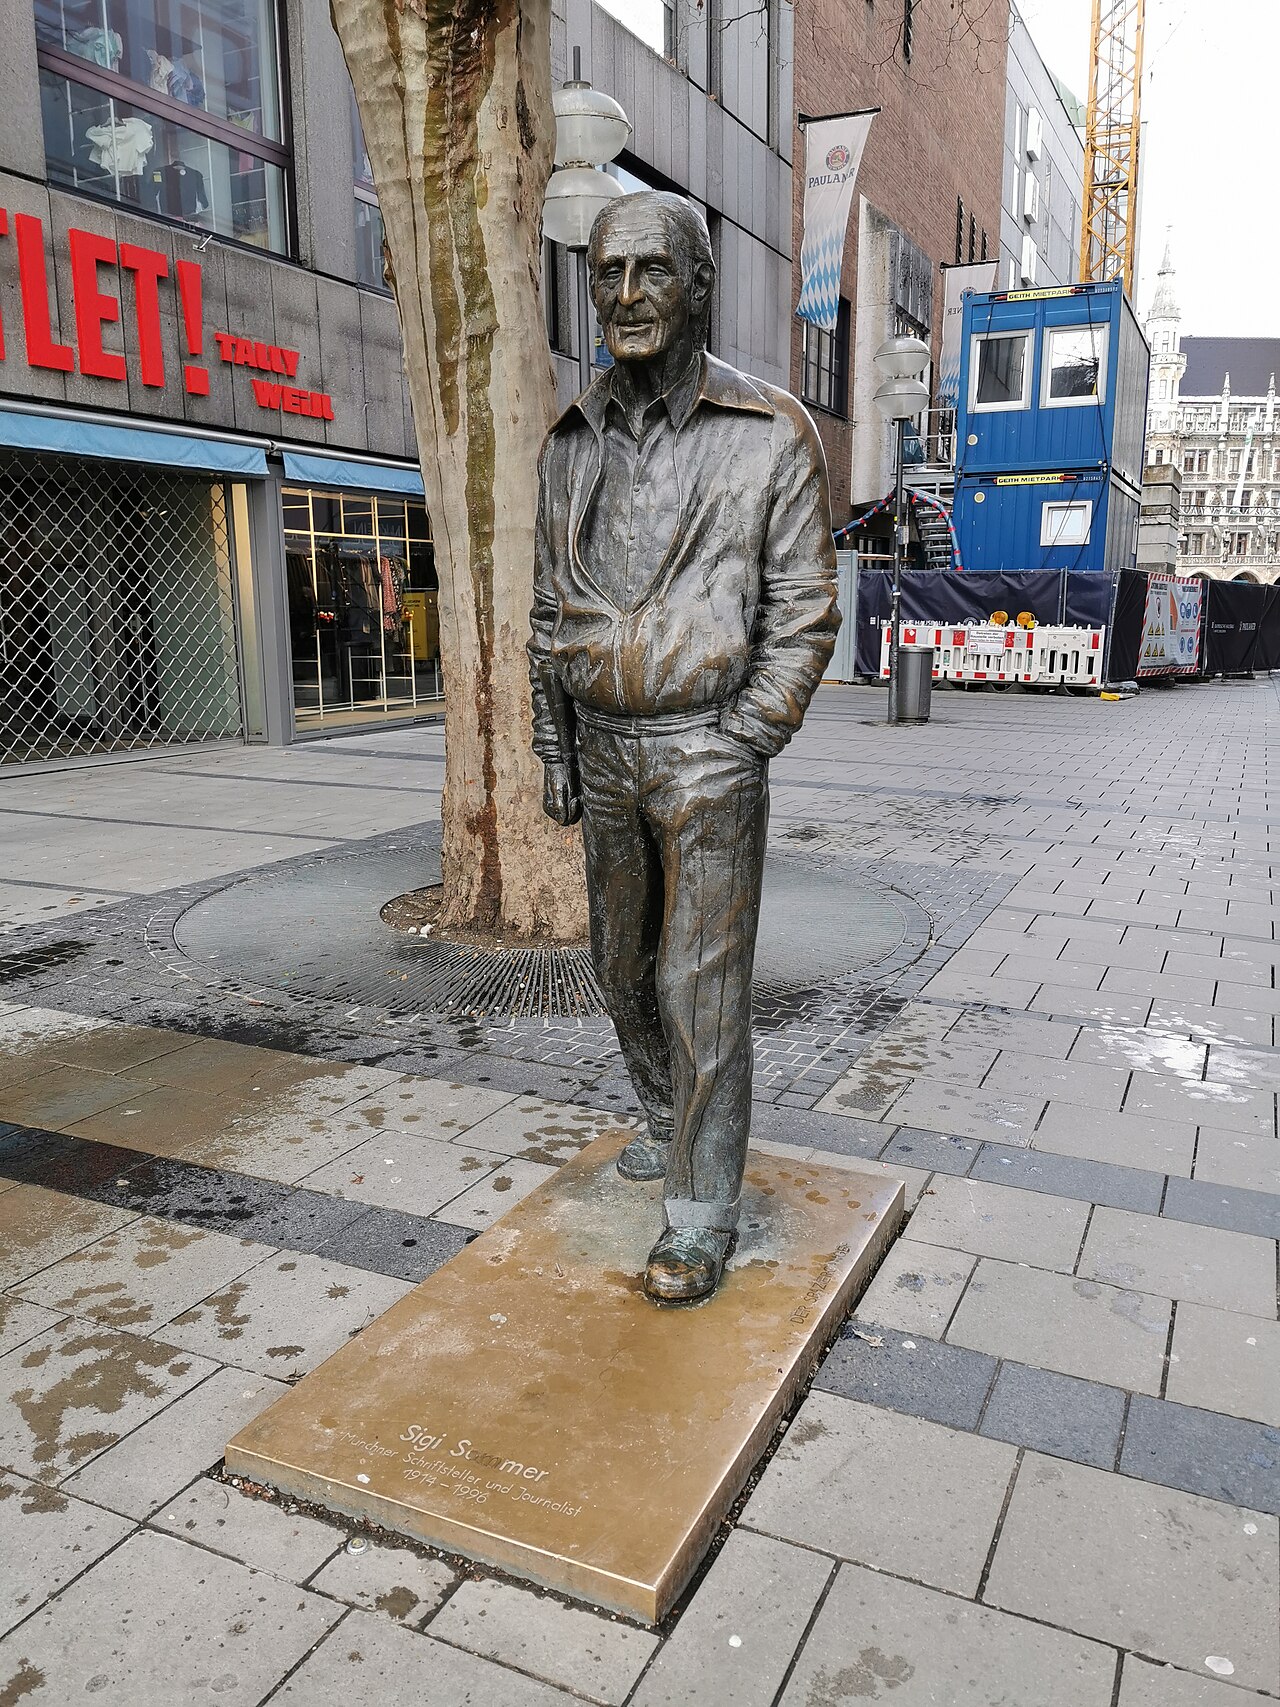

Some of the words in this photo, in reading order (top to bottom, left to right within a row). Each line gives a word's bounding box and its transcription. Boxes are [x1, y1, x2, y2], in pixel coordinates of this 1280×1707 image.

[808, 167, 856, 189] PAULANR
[0, 207, 210, 396] LET!
[214, 332, 300, 377] TALLY
[790, 1305, 813, 1325] DER
[400, 1424, 447, 1452] Sigi
[340, 1432, 399, 1457] Münchner
[402, 1452, 482, 1485] Schriftsteller
[485, 1480, 514, 1494] und
[511, 1486, 582, 1517] Journalist
[403, 1469, 437, 1487] 1914
[452, 1483, 489, 1504] 1996
